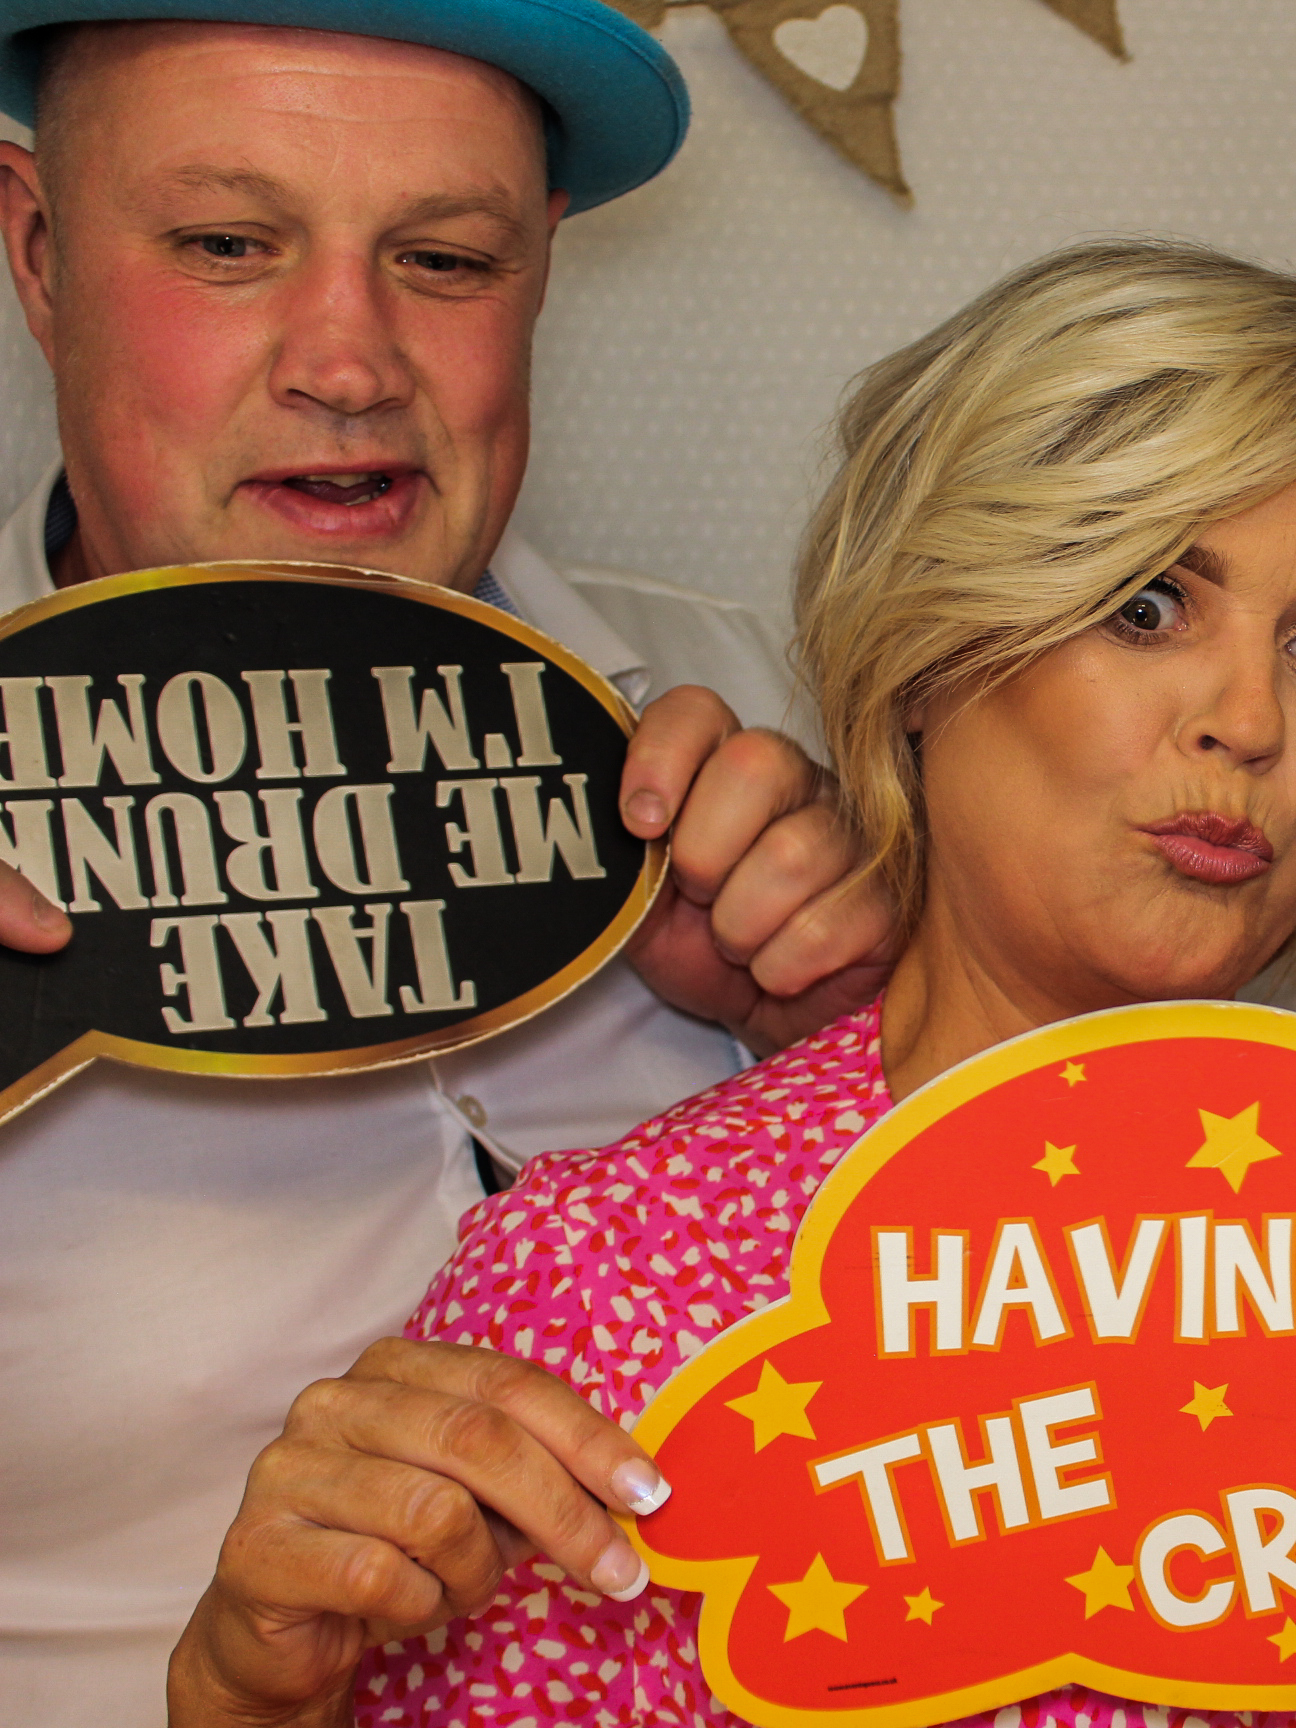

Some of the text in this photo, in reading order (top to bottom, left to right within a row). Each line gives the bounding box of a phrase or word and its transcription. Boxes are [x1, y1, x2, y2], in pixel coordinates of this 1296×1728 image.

[371, 661, 562, 773] I'M
[435, 773, 607, 888] ME
[150, 899, 477, 1034] TAKE
[813, 1387, 1111, 1562] THE
